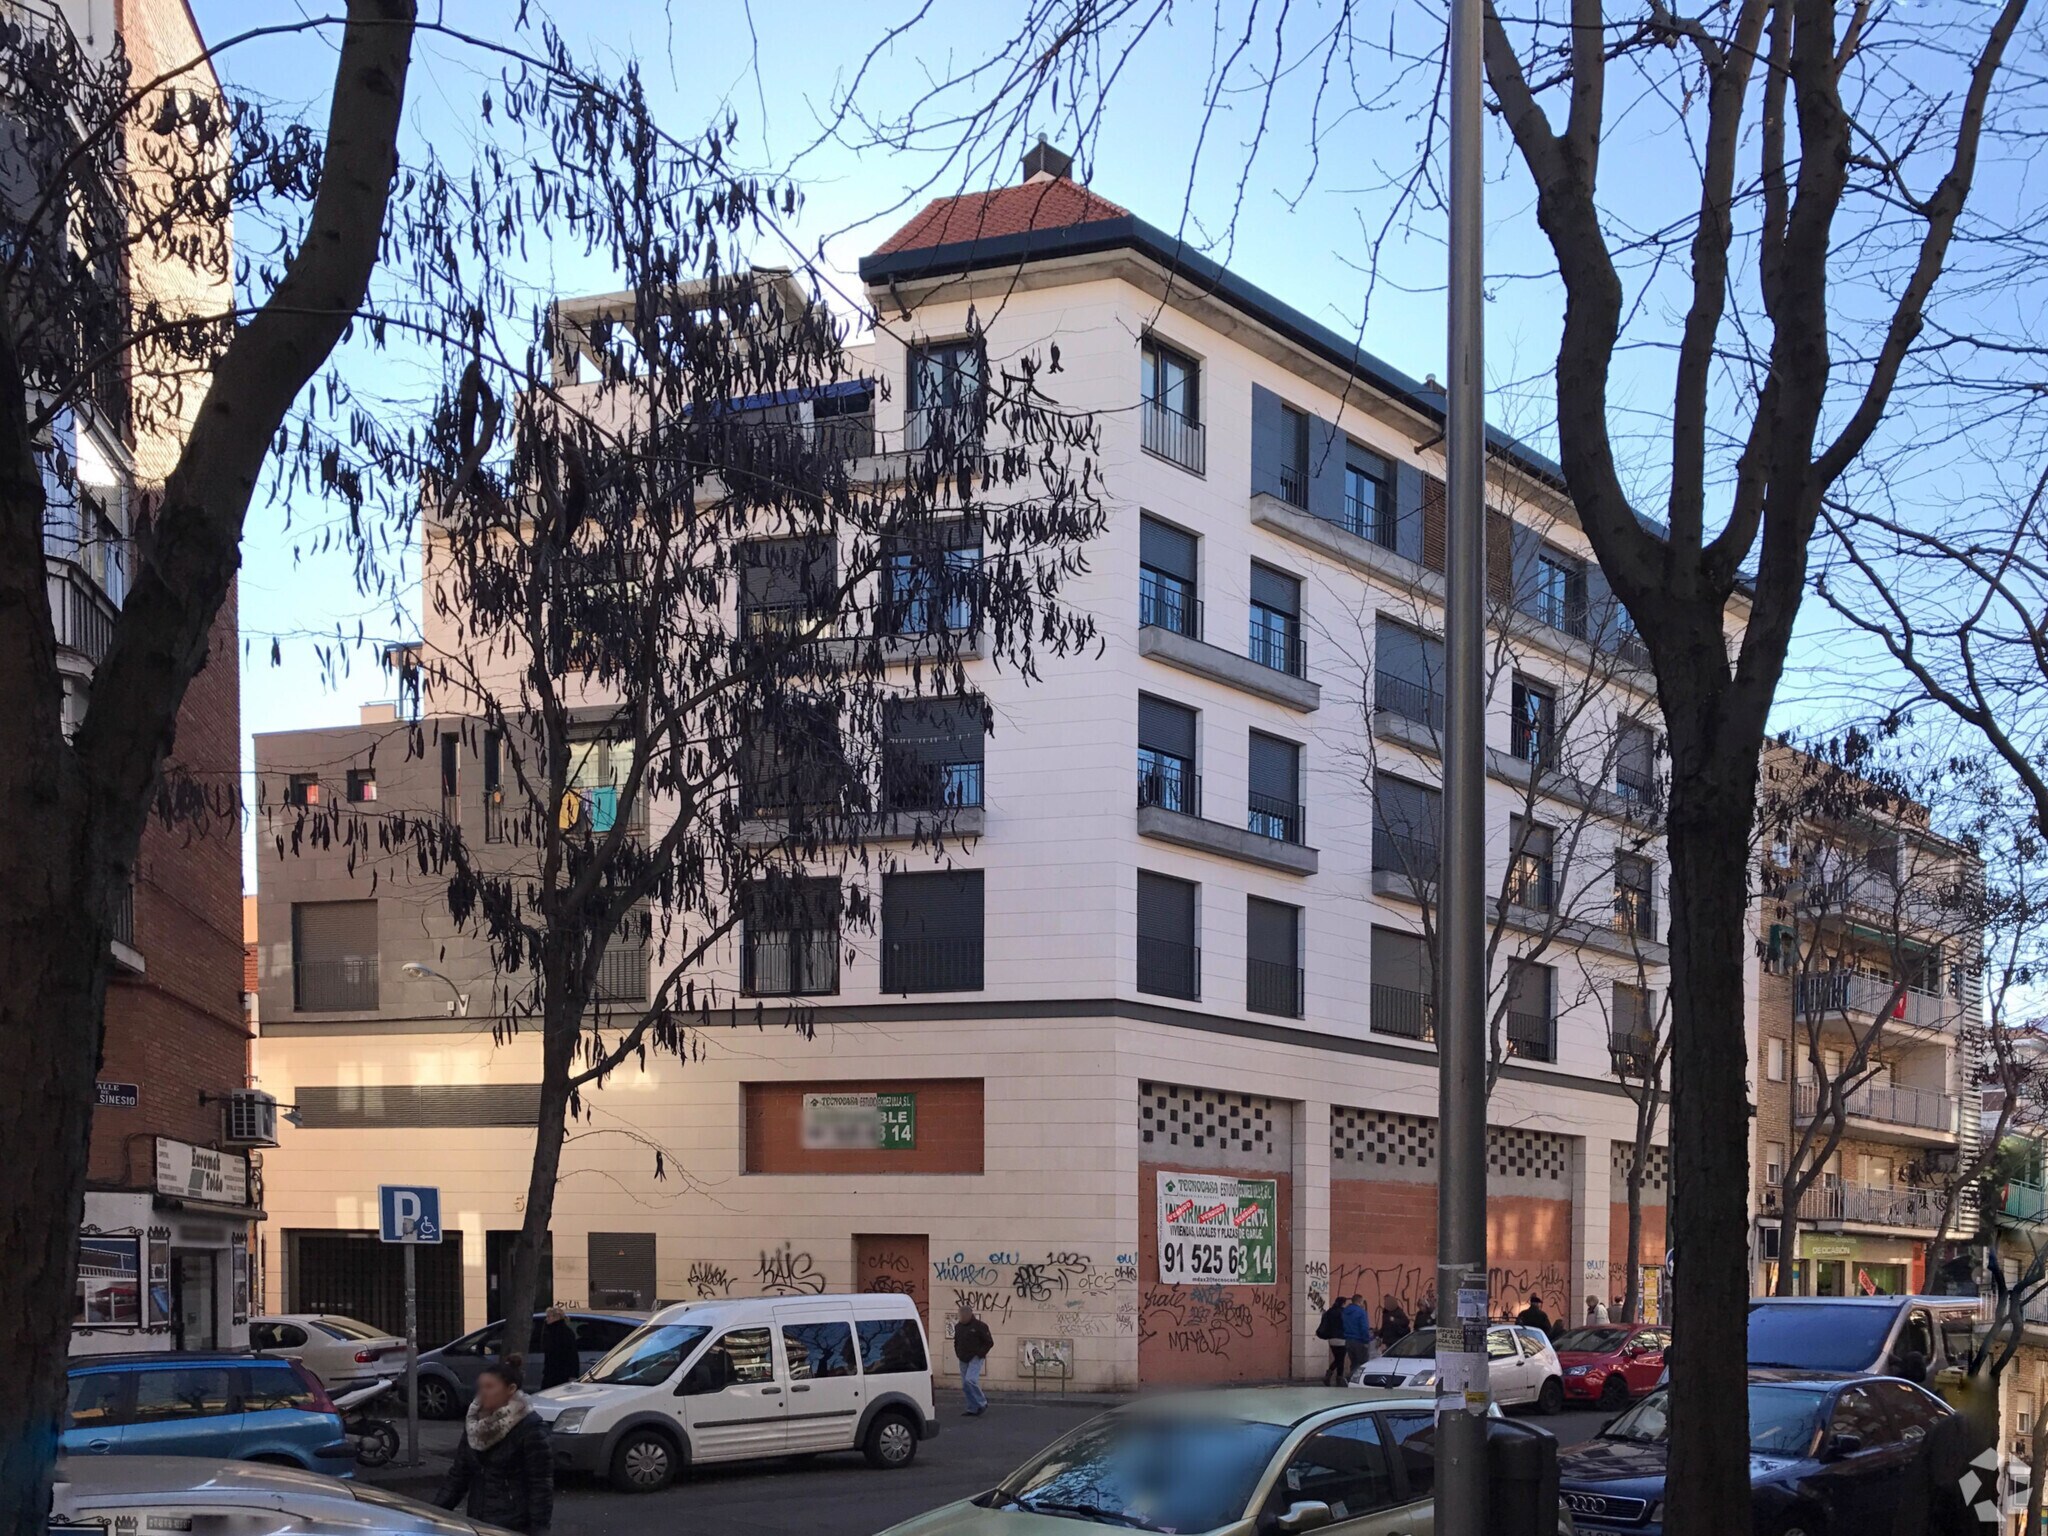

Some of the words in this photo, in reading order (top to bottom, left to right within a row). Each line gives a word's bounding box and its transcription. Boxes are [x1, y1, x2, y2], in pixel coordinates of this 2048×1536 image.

[96, 1083, 120, 1091] ALLE
[100, 1094, 136, 1106] SINESIO
[891, 1125, 912, 1141] 14
[1178, 1179, 1218, 1194] TECNOCASA
[393, 1190, 421, 1237] P
[1164, 1242, 1184, 1273] 91
[1191, 1244, 1223, 1275] 525
[1228, 1245, 1248, 1275] 63
[1252, 1245, 1273, 1277] 14
